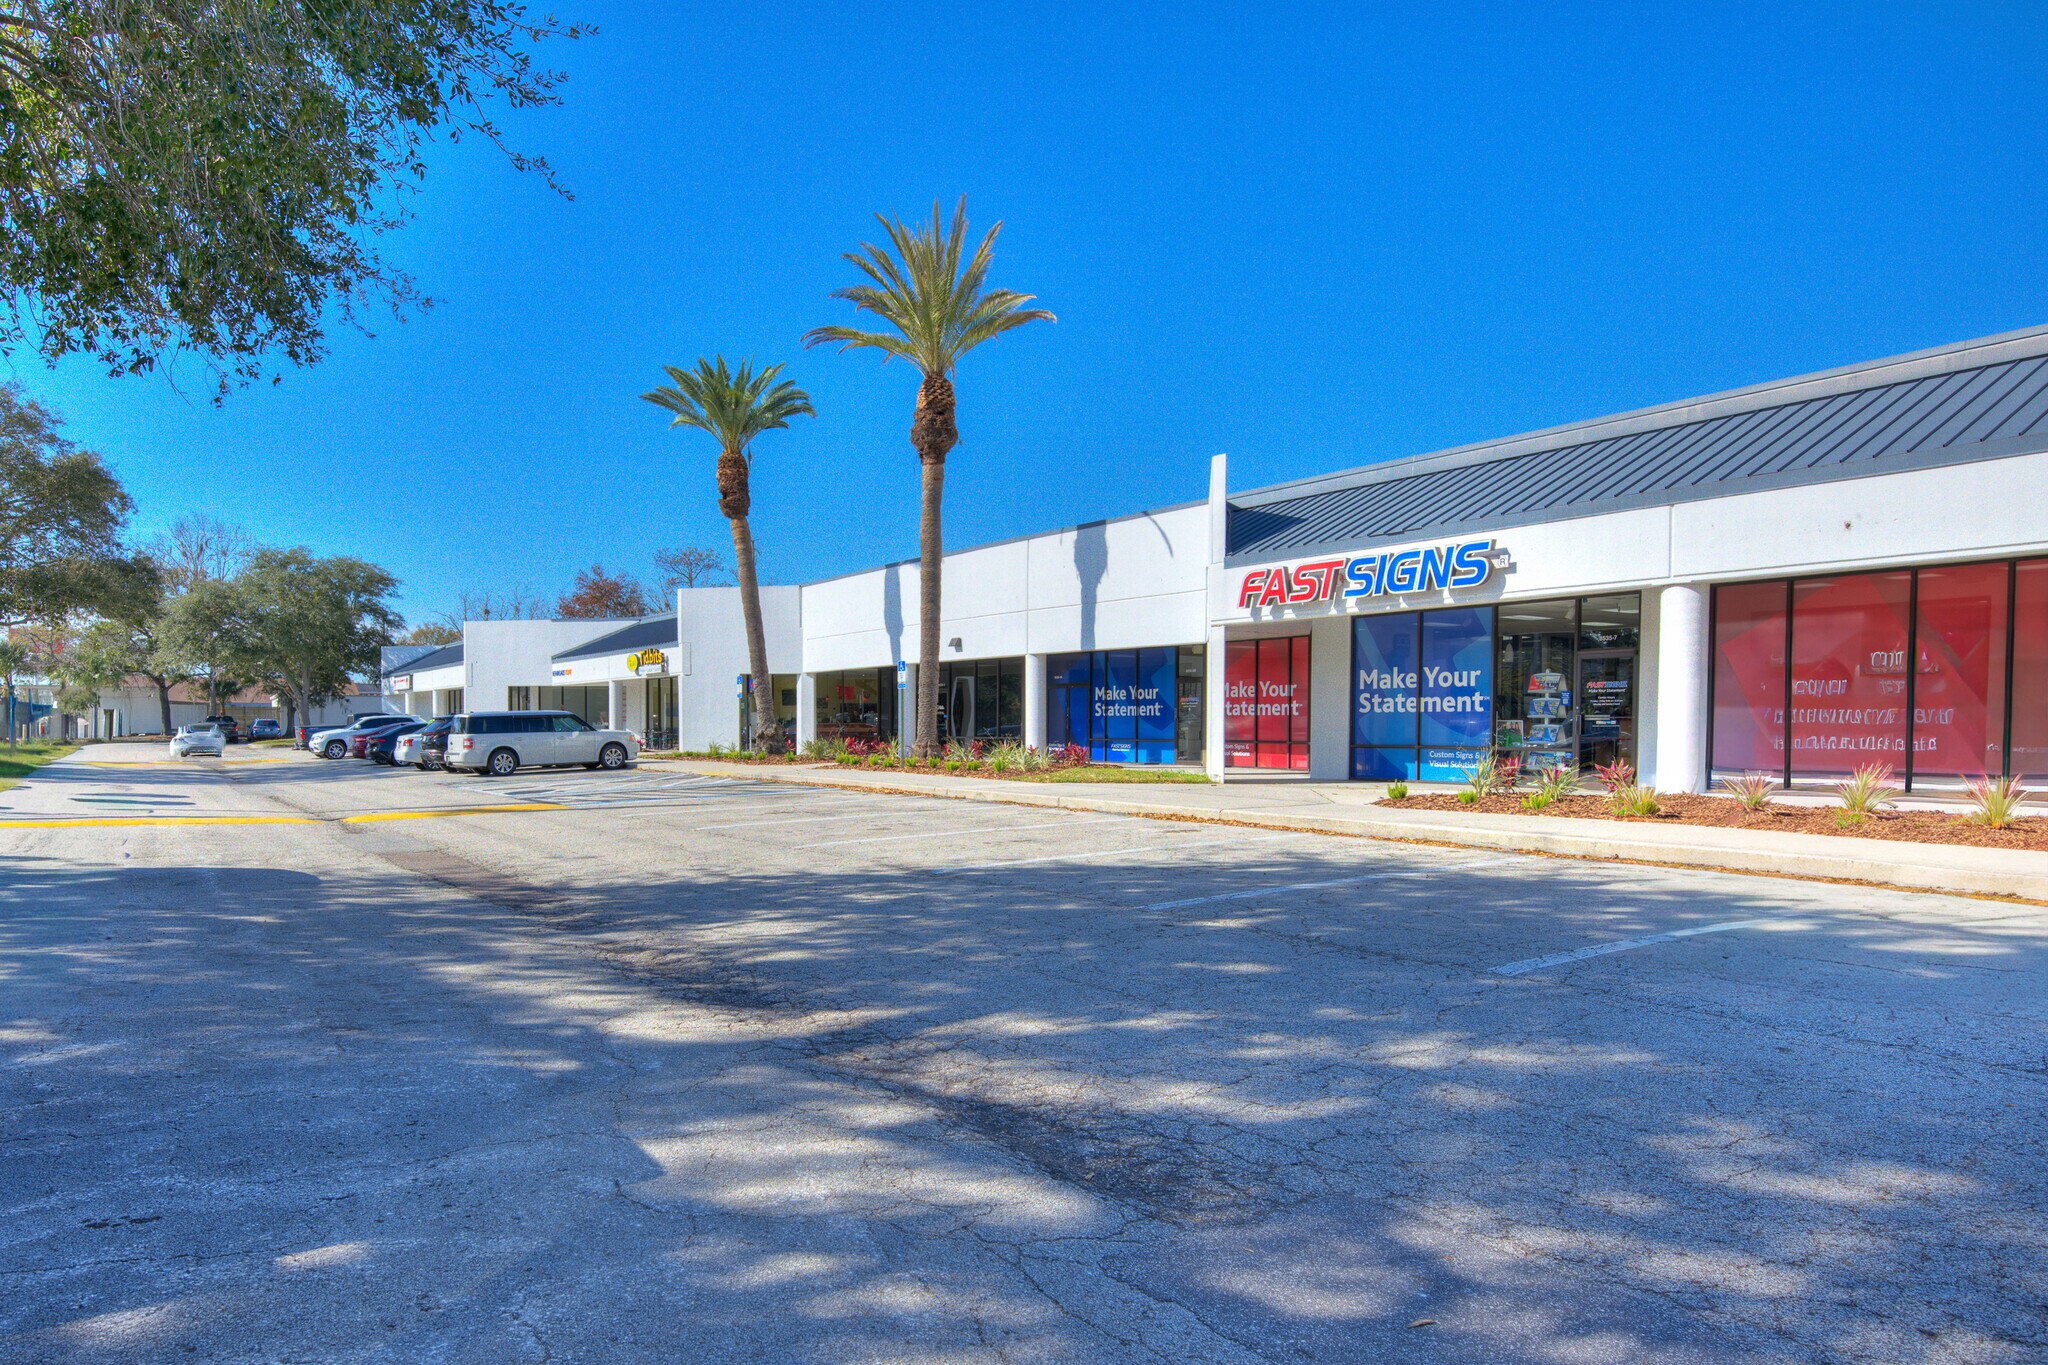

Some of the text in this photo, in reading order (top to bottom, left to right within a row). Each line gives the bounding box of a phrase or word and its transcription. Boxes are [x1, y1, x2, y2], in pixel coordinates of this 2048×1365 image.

[1237, 540, 1493, 608] FASTSIGNS
[638, 648, 663, 665] Tidbits
[1359, 666, 1481, 690] Make Your
[1095, 685, 1159, 700] Make Your
[1259, 680, 1297, 697] Your
[1094, 702, 1161, 716] Statement
[1225, 700, 1299, 716] tatement
[1358, 691, 1485, 713] Statement
[1456, 751, 1473, 761] Signs
[1429, 760, 1478, 769] Visual Solution
